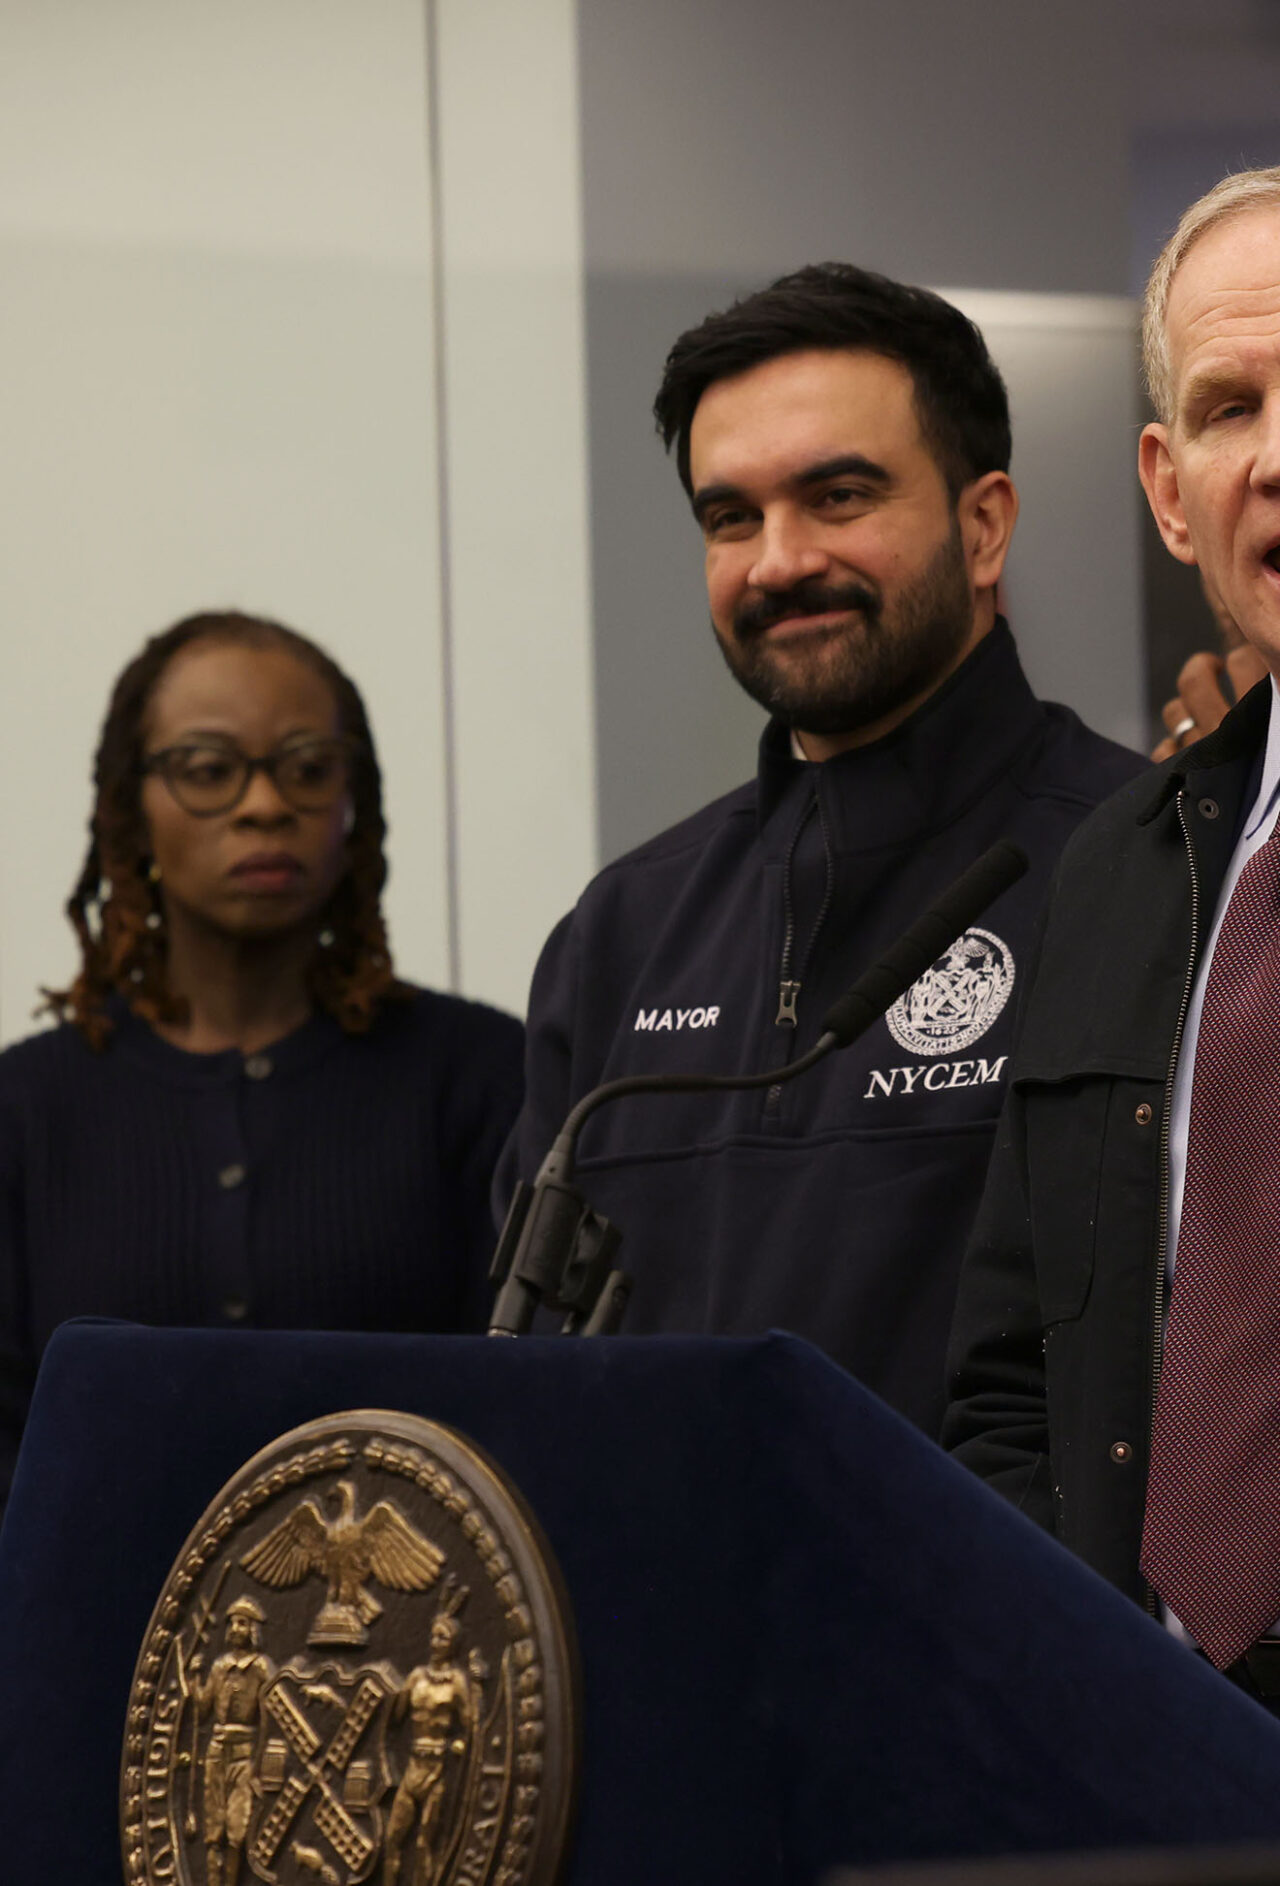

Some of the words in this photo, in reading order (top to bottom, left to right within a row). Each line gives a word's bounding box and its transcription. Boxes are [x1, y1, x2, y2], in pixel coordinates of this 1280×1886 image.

[633, 1005, 721, 1032] MAYOR
[863, 1056, 1008, 1099] NYCEM
[147, 1690, 179, 1886] SIGILLV
